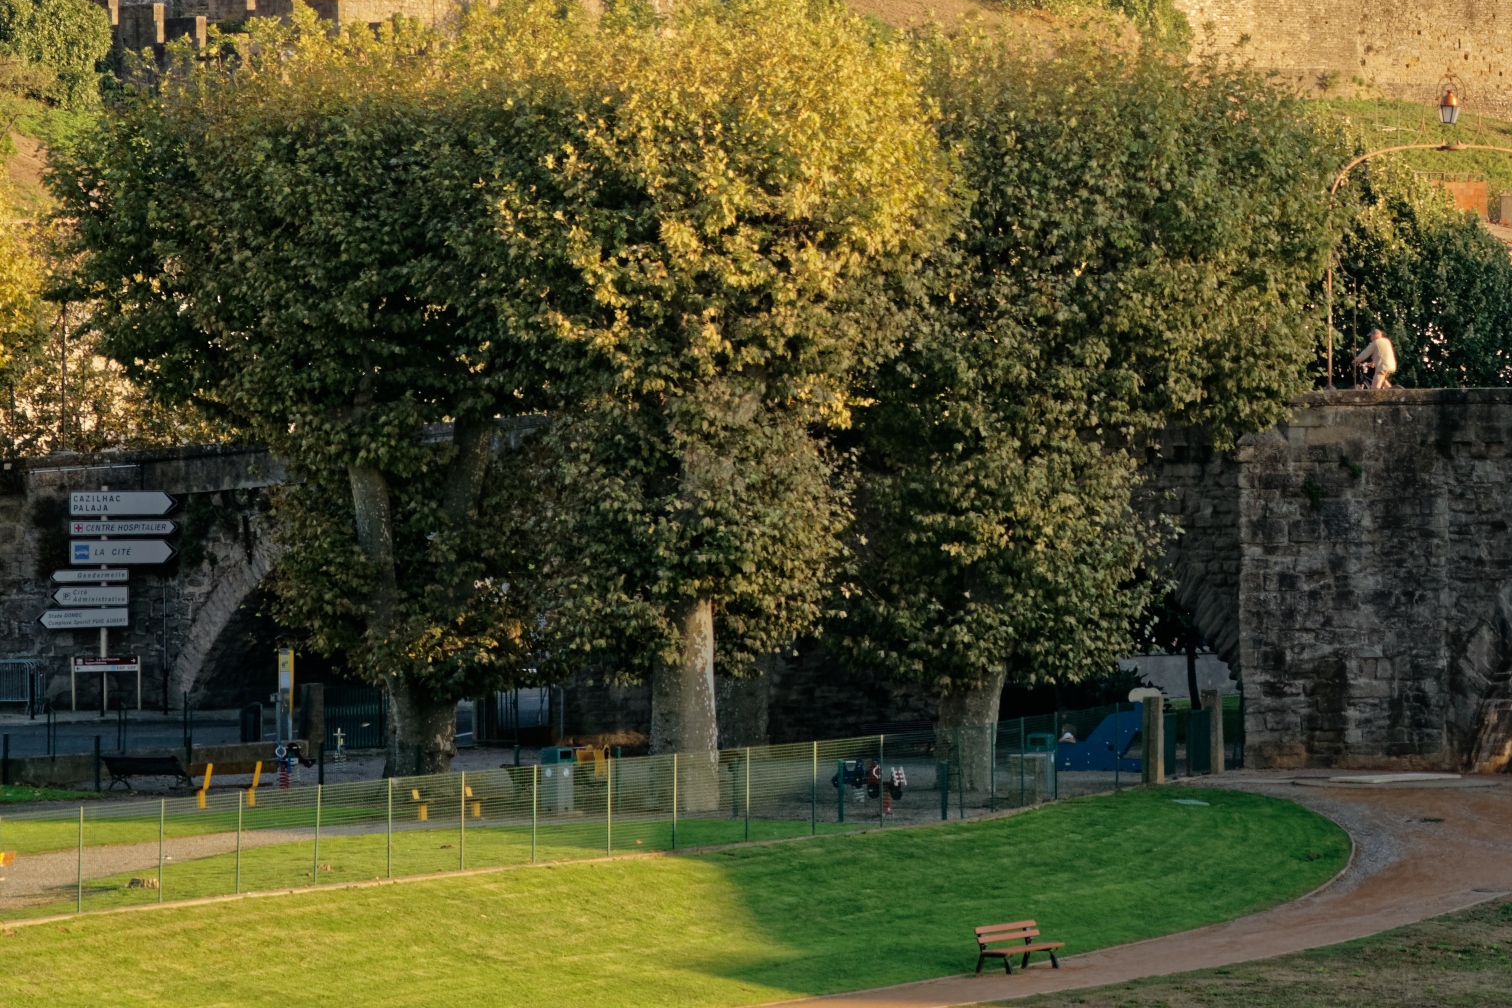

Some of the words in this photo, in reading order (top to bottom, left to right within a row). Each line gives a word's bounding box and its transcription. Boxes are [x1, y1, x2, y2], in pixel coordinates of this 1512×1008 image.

[73, 504, 109, 512] PALAJA
[86, 524, 115, 532] CENTRE
[117, 523, 167, 531] HOSPITALIER
[94, 548, 105, 556] LA
[111, 546, 131, 556] CITÉ
